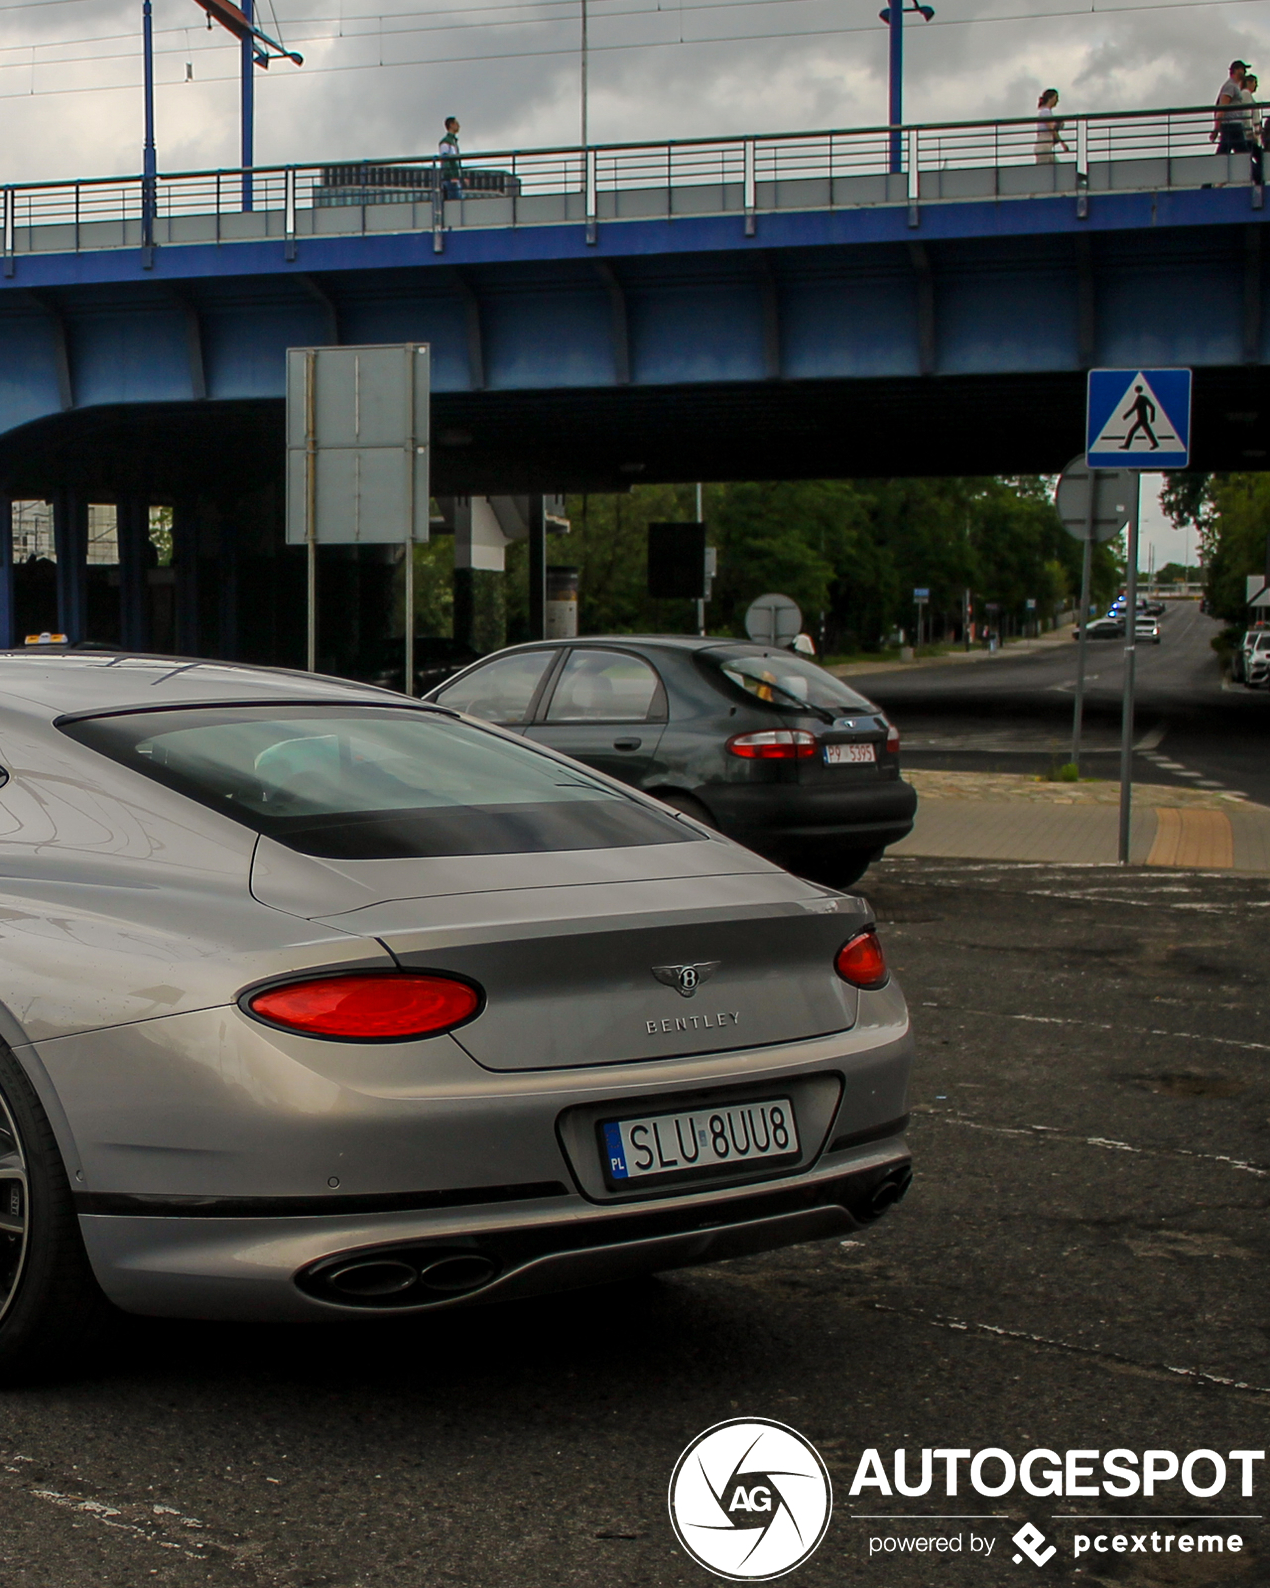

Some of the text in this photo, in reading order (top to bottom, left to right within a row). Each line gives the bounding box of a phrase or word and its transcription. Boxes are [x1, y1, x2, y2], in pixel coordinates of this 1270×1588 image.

[828, 744, 873, 762] P9 5395
[645, 1011, 741, 1035] BENTLEY
[629, 1105, 790, 1171] SLU 8UU8
[611, 1157, 625, 1172] PL
